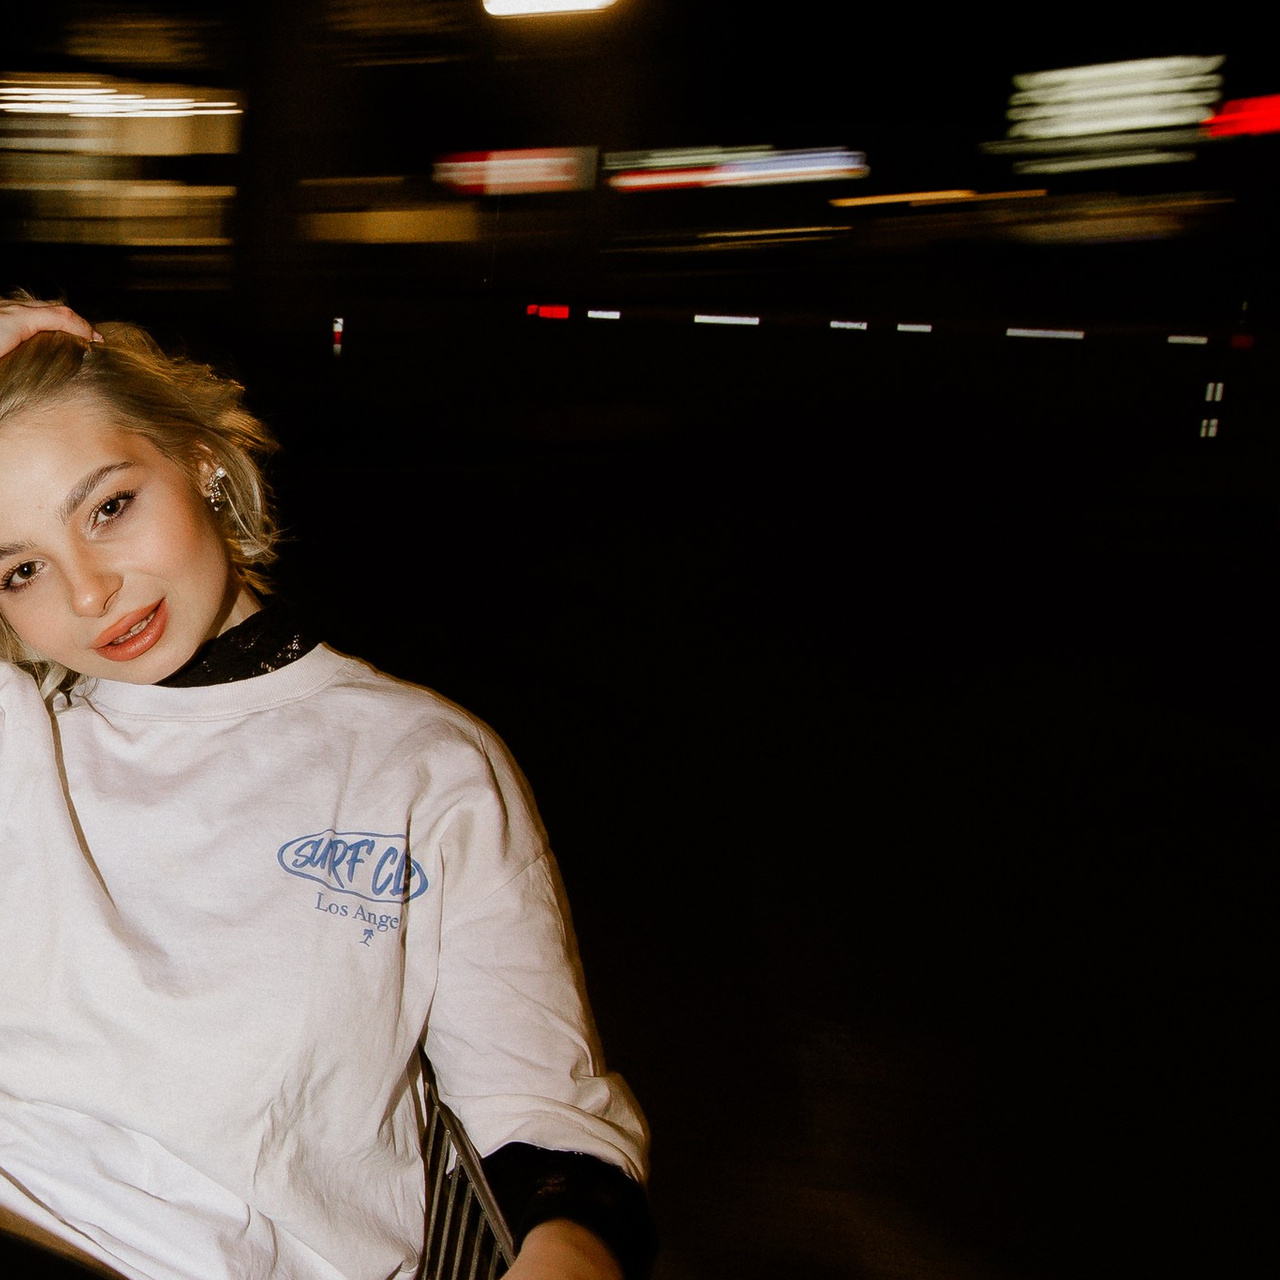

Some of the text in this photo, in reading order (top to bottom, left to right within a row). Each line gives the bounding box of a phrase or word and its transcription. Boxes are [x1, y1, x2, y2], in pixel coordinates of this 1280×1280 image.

[291, 837, 376, 889] SURF
[314, 891, 400, 933] Los Ange
